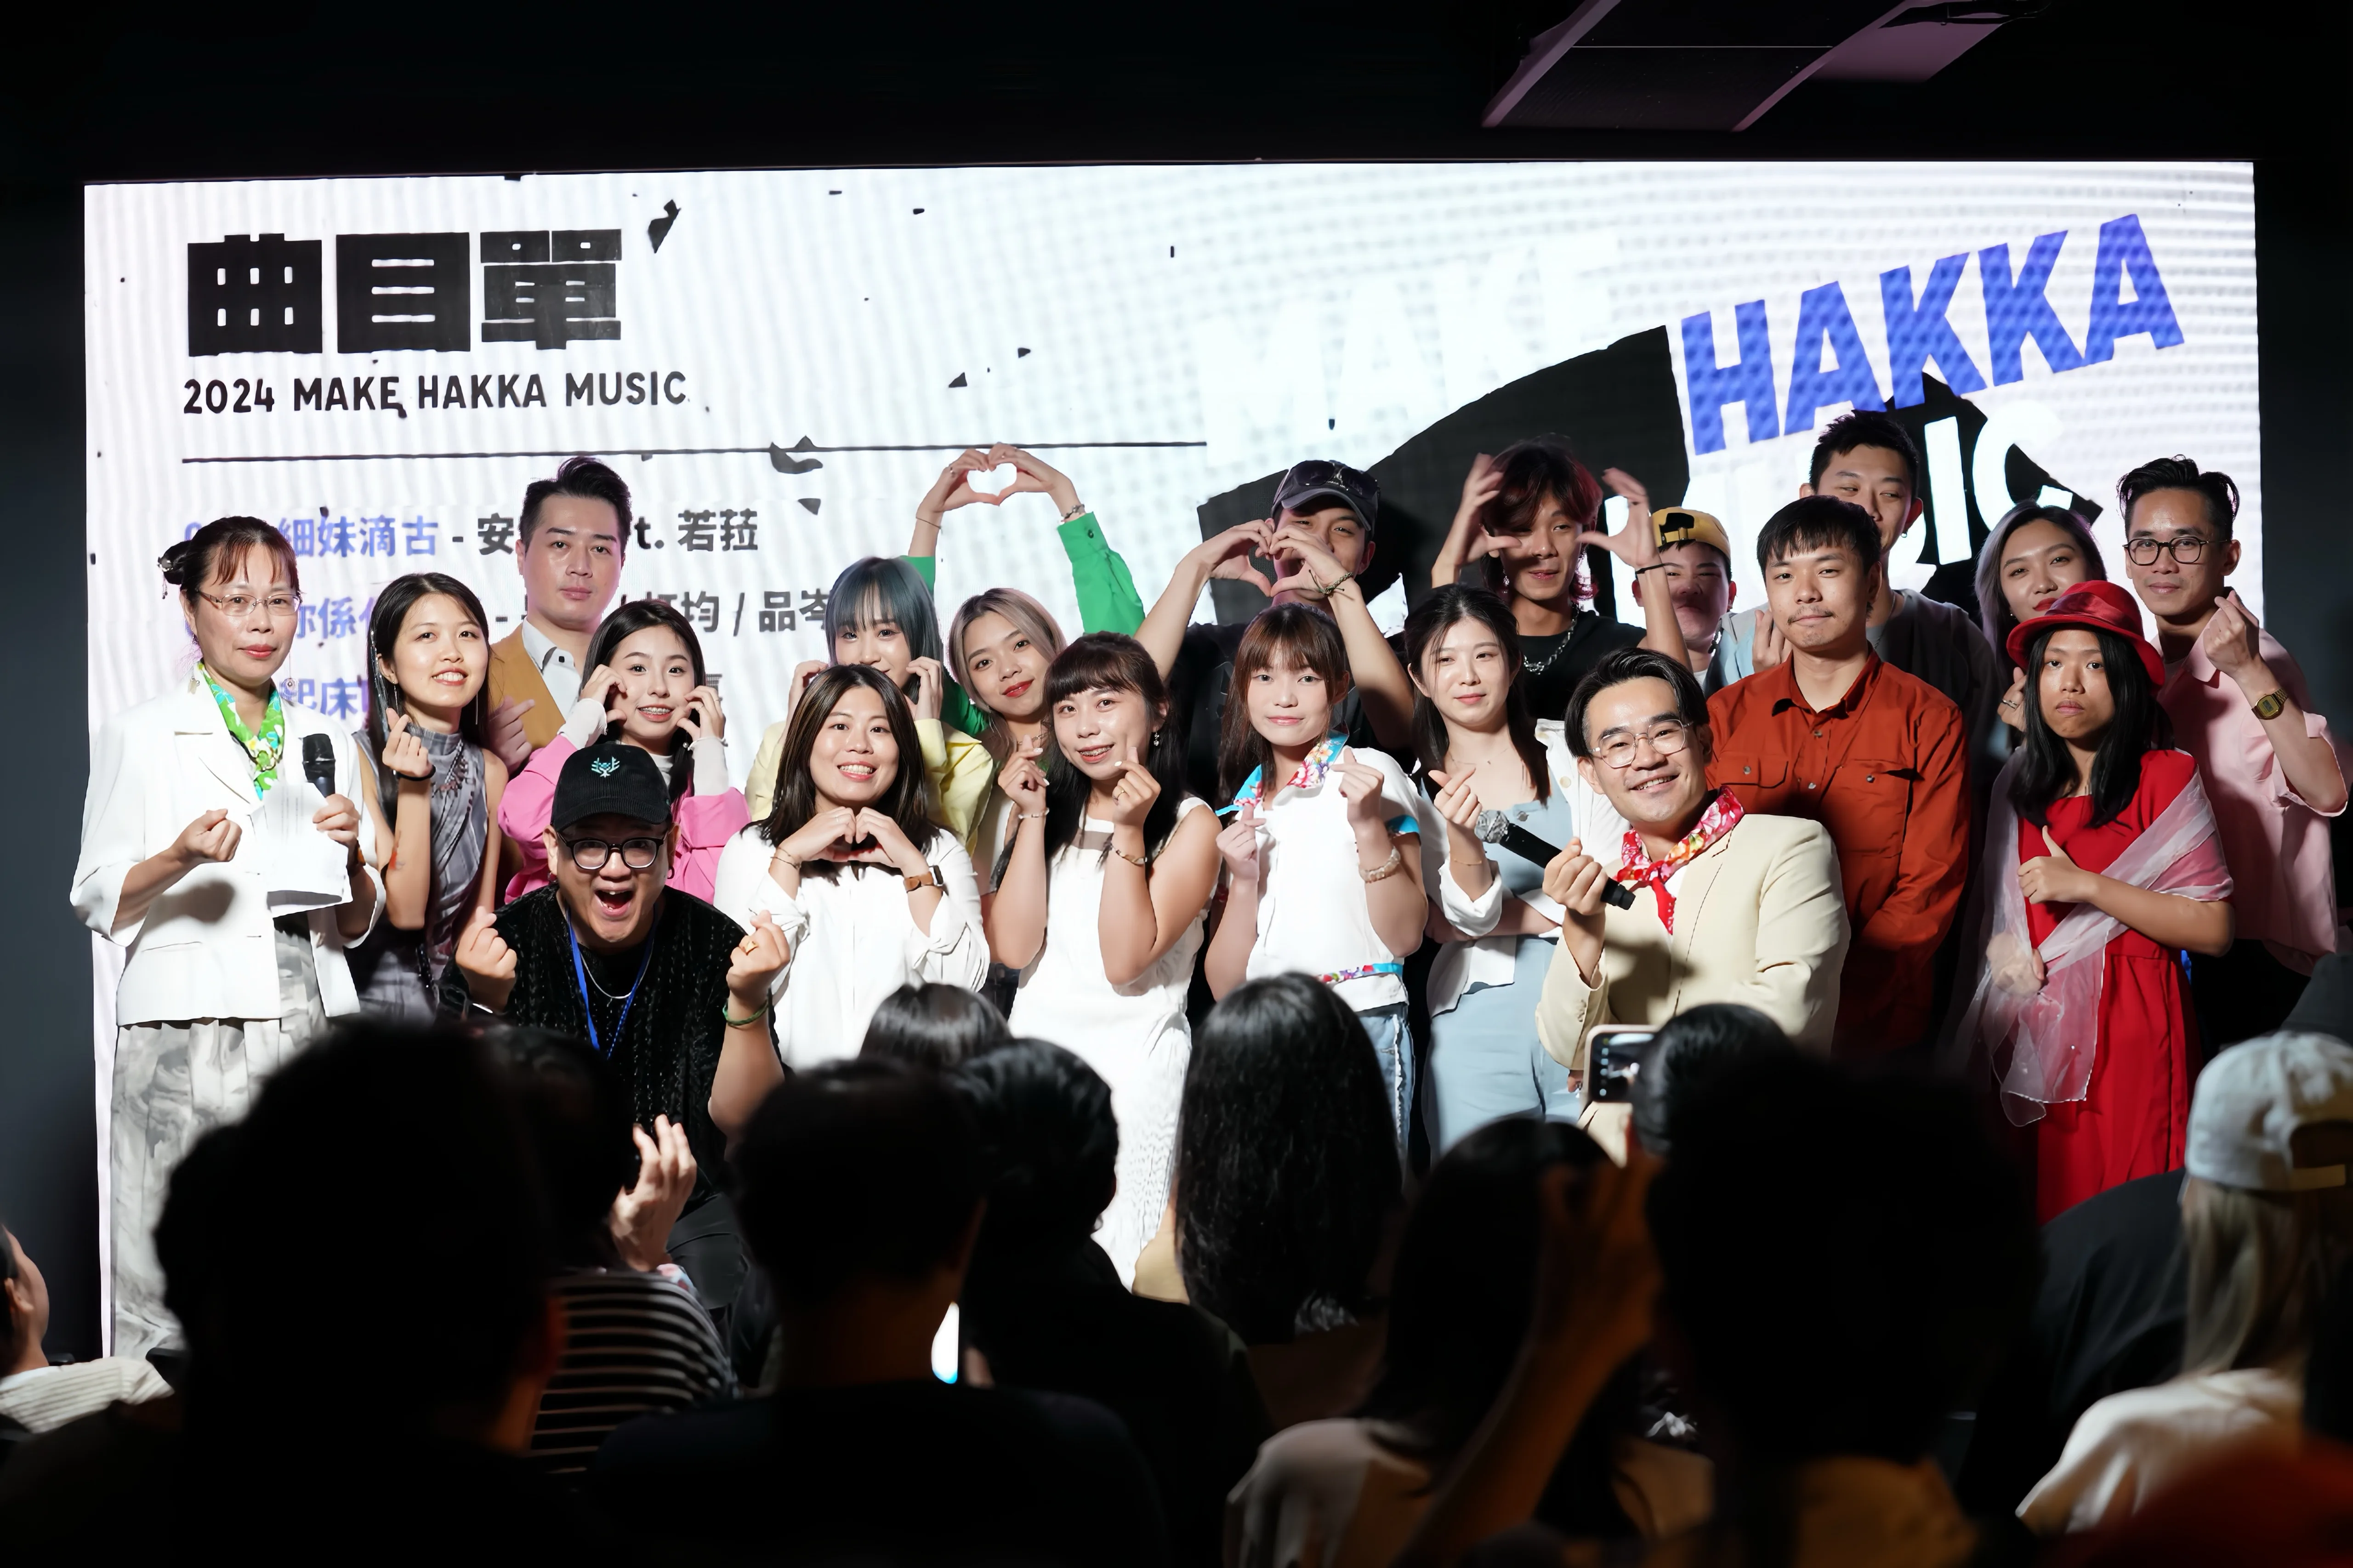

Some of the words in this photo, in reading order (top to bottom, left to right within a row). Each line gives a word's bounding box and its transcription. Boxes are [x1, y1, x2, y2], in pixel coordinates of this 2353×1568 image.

[188, 229, 621, 357] 曲目單
[1681, 214, 2184, 455] HAKKA
[184, 378, 275, 414] 2024
[294, 376, 399, 411] MAKE
[419, 374, 547, 409] HAKKA
[566, 371, 686, 406] MUSIC
